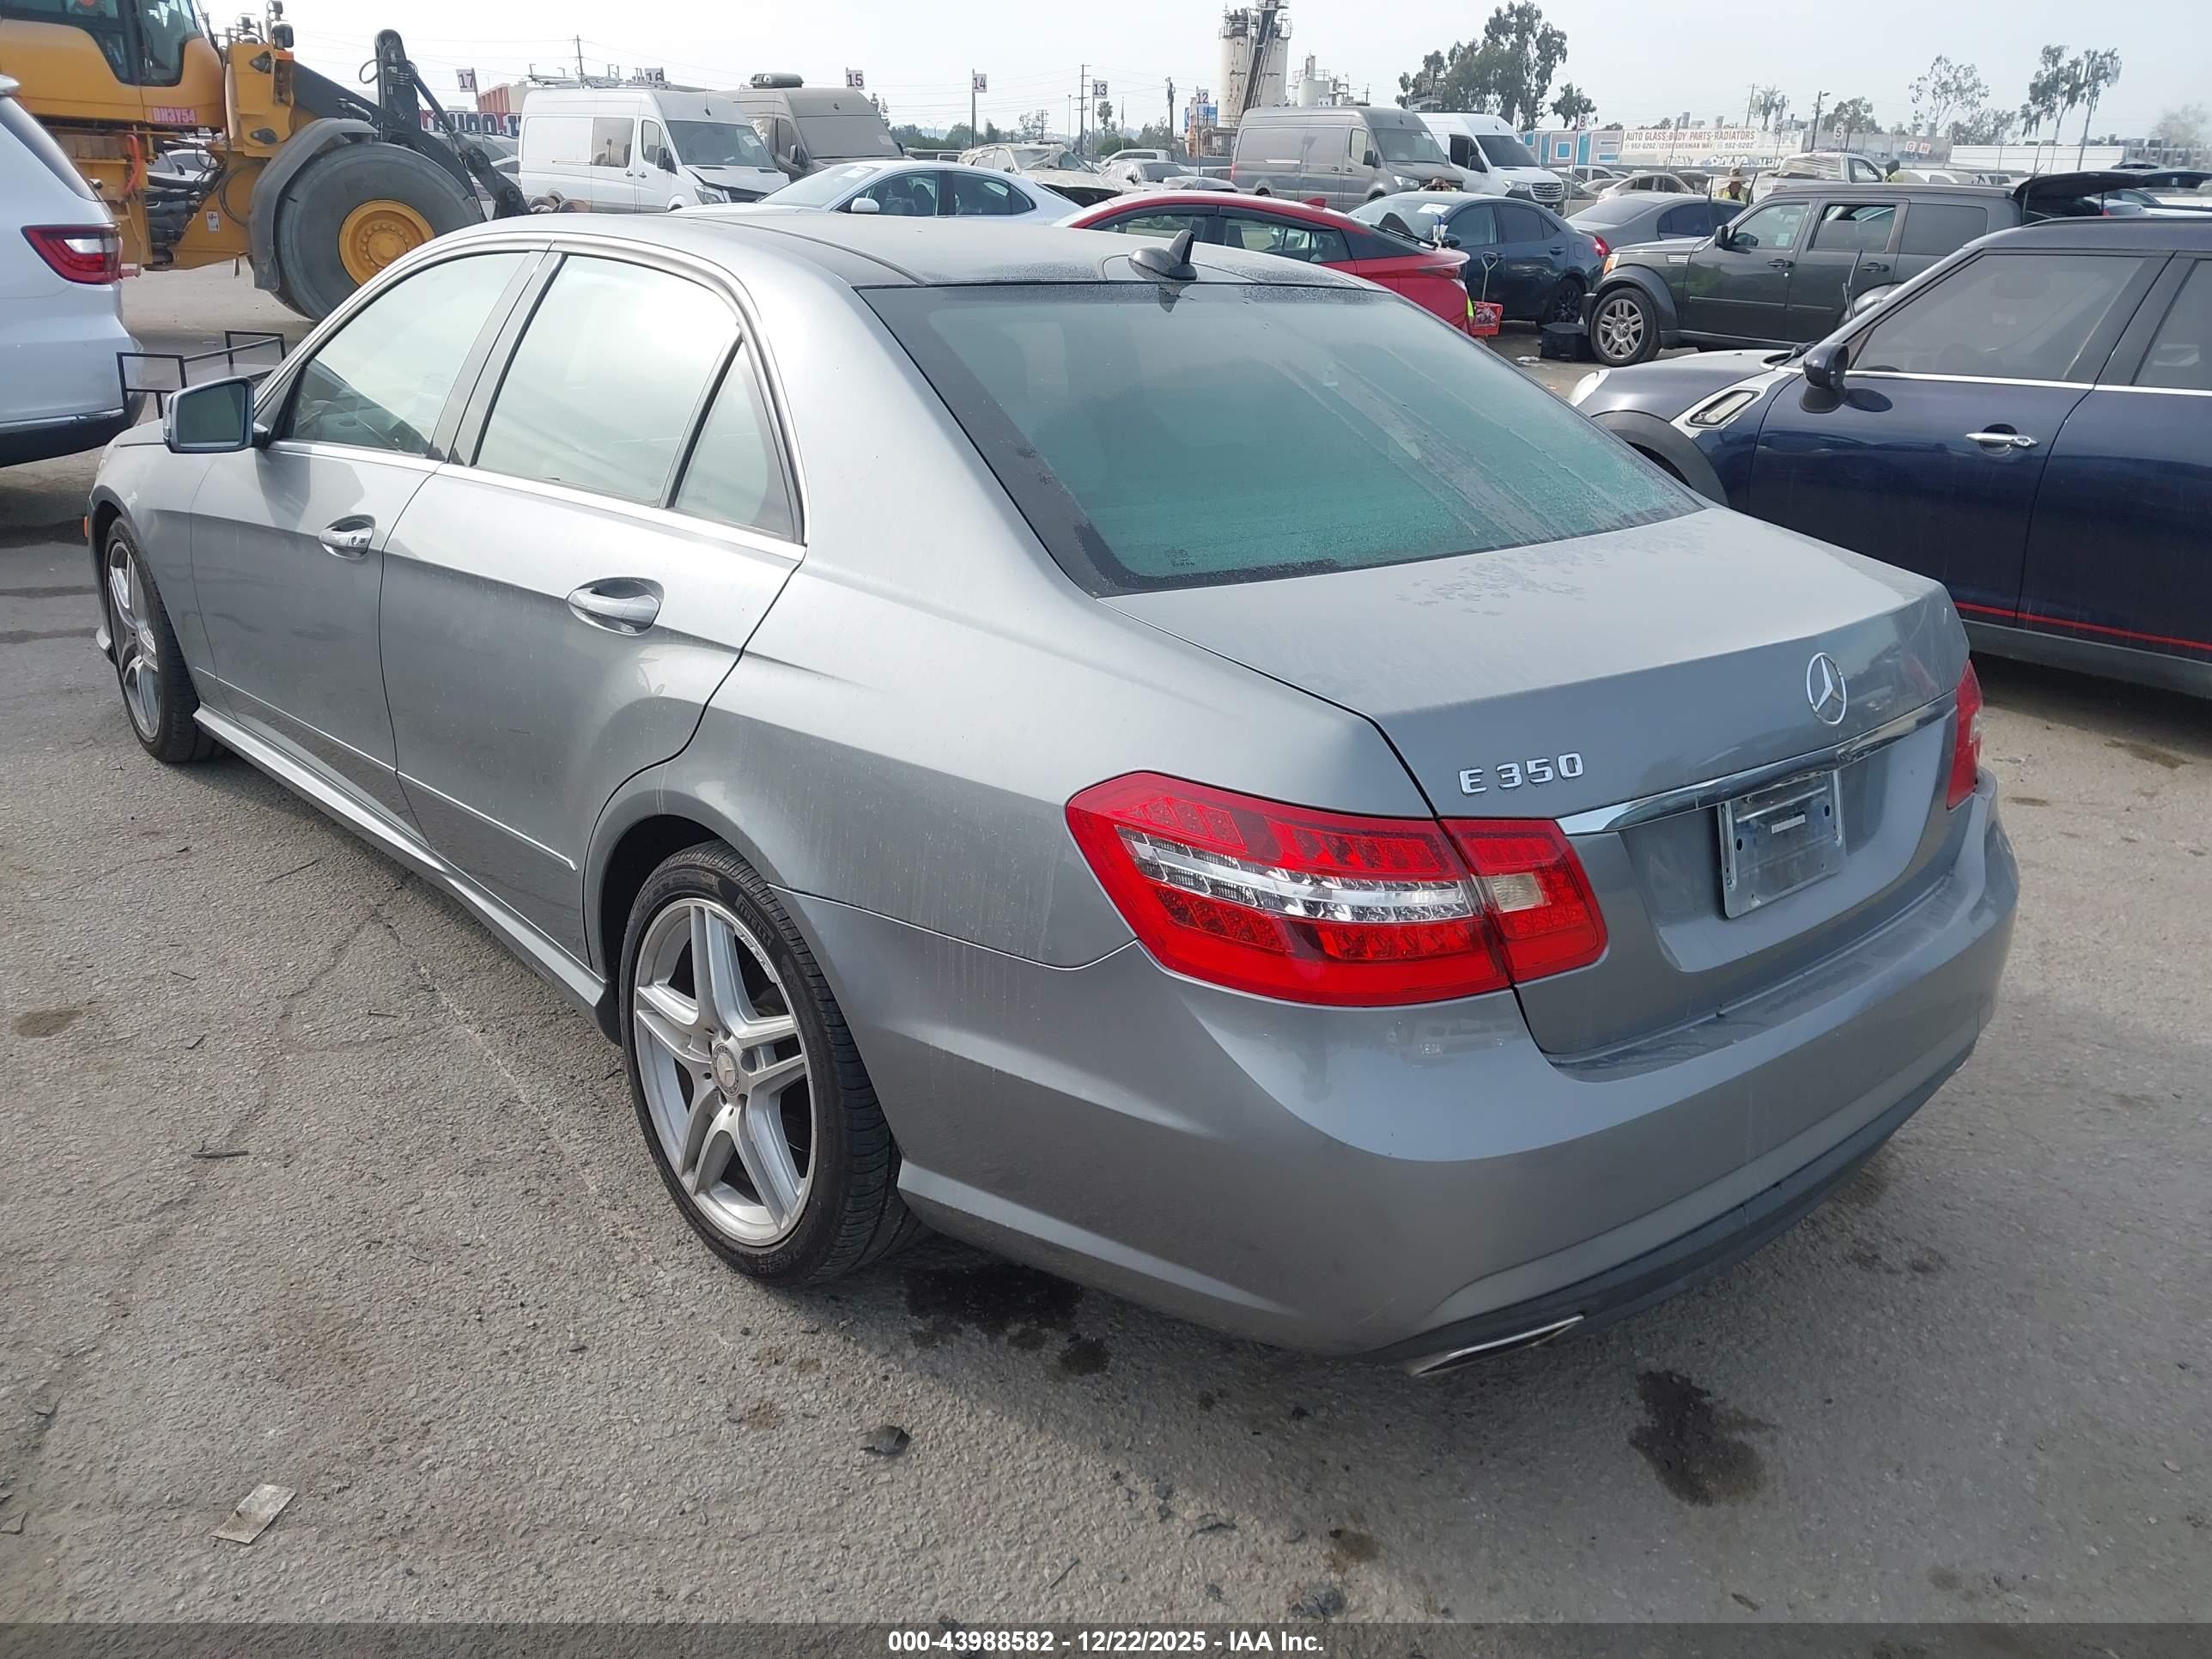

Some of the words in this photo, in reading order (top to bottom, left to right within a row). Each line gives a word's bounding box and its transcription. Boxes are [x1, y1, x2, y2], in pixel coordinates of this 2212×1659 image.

[458, 73, 474, 88] 17
[847, 74, 863, 87] 15
[973, 77, 986, 89] 14
[1093, 83, 1107, 95] 13
[1196, 93, 1208, 103] 12
[1580, 115, 1586, 127] 8
[1625, 132, 1643, 141] AUTO
[1835, 127, 1842, 138] 5
[1907, 143, 1915, 151] G
[1459, 769, 1487, 794] E
[1496, 752, 1584, 789] 350
